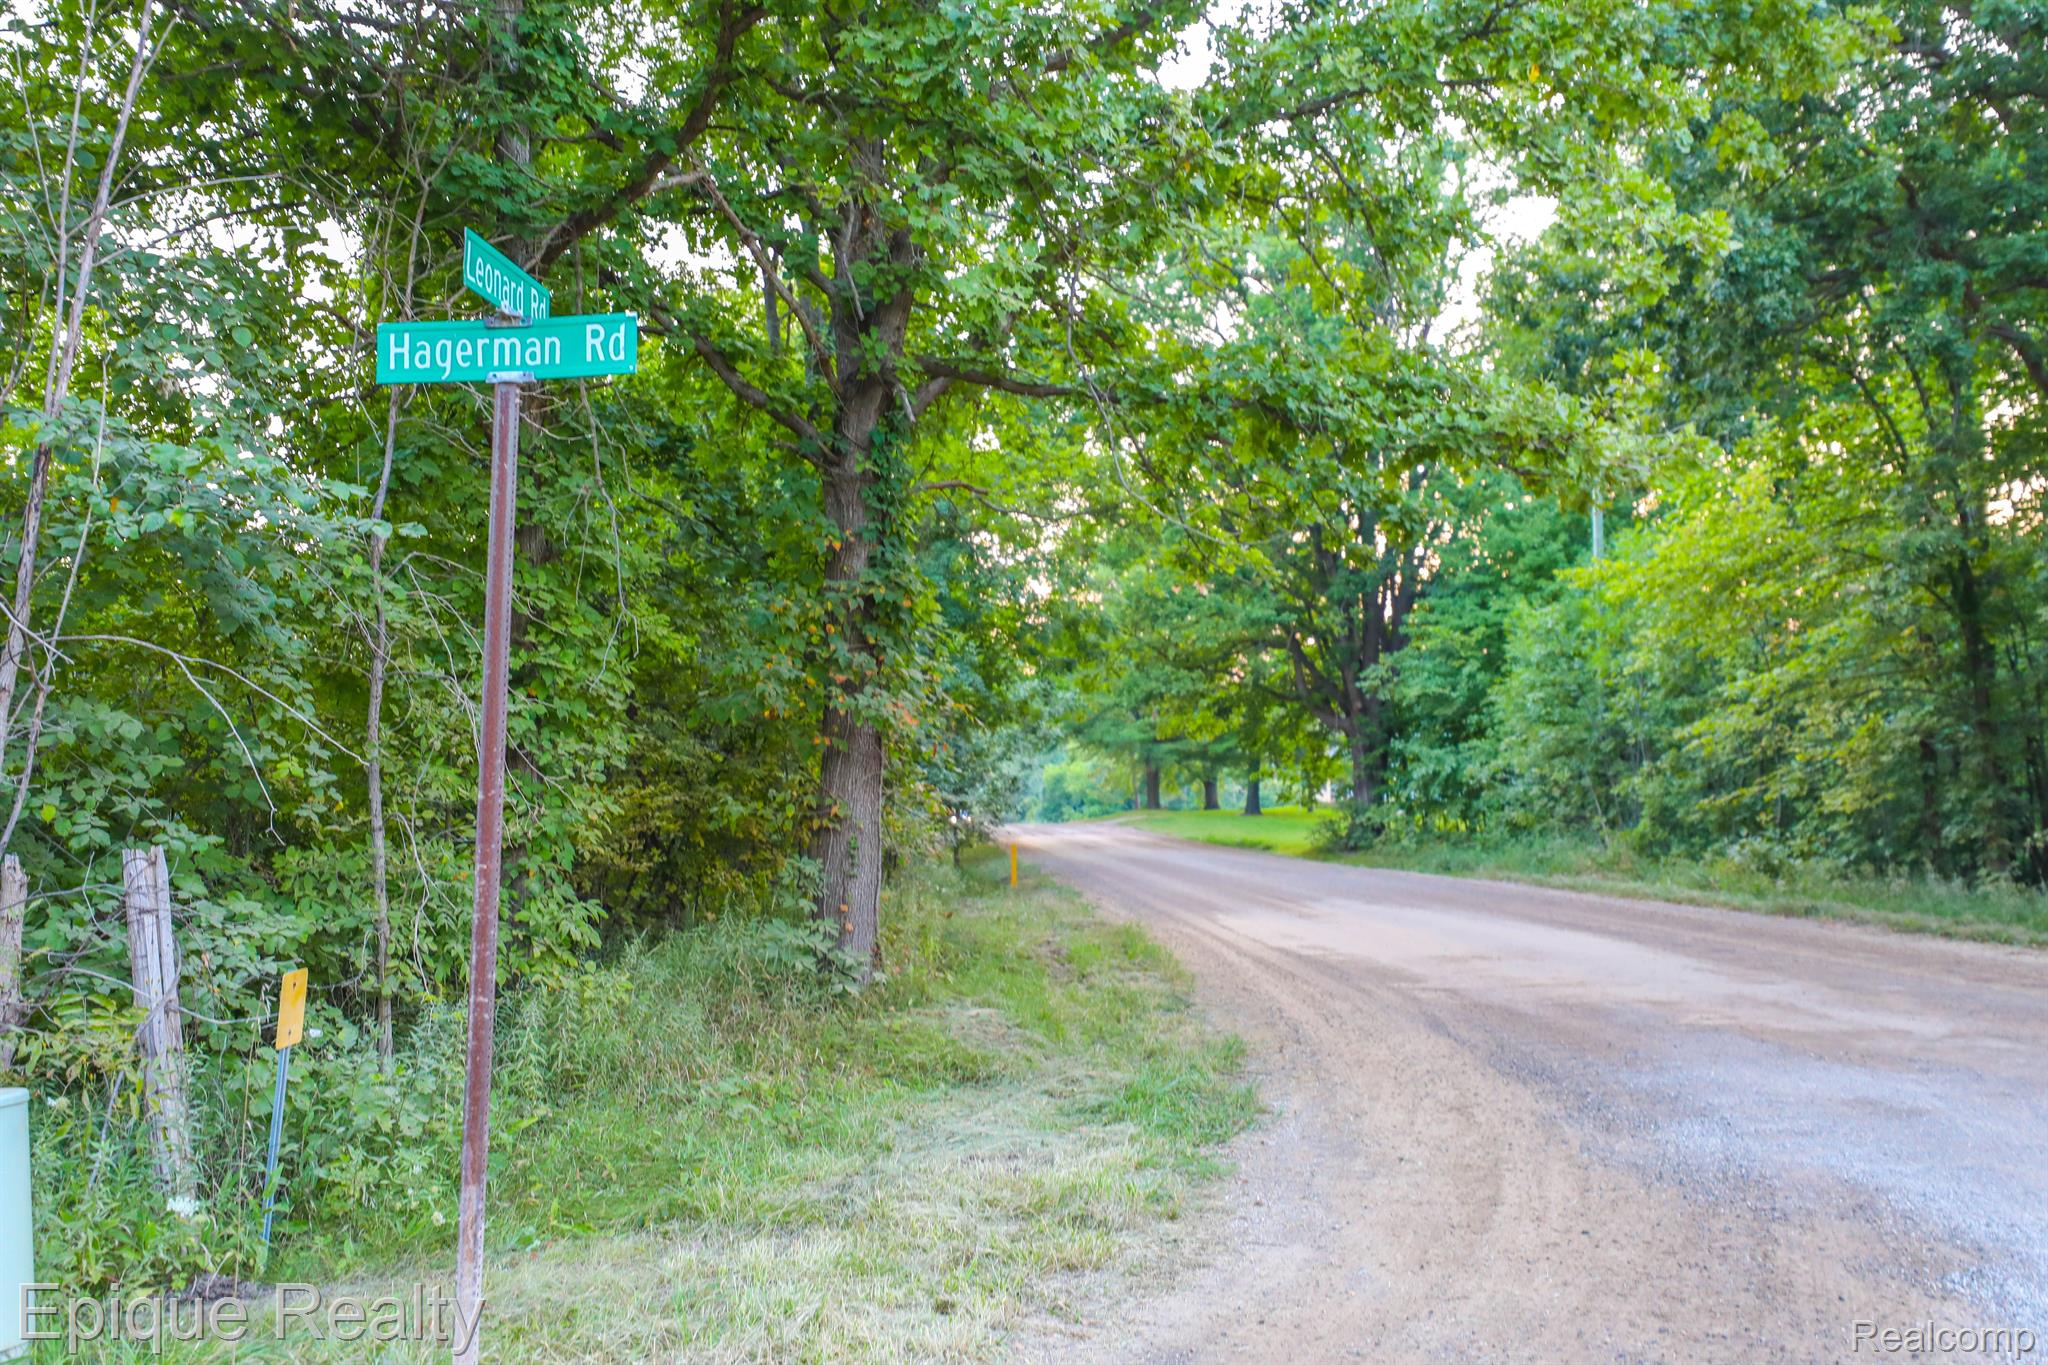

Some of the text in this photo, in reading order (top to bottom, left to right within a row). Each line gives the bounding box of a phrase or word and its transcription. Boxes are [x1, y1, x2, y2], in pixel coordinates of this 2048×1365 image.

[466, 239, 546, 320] Leonard Rd
[389, 322, 626, 380] Hagerman Rd
